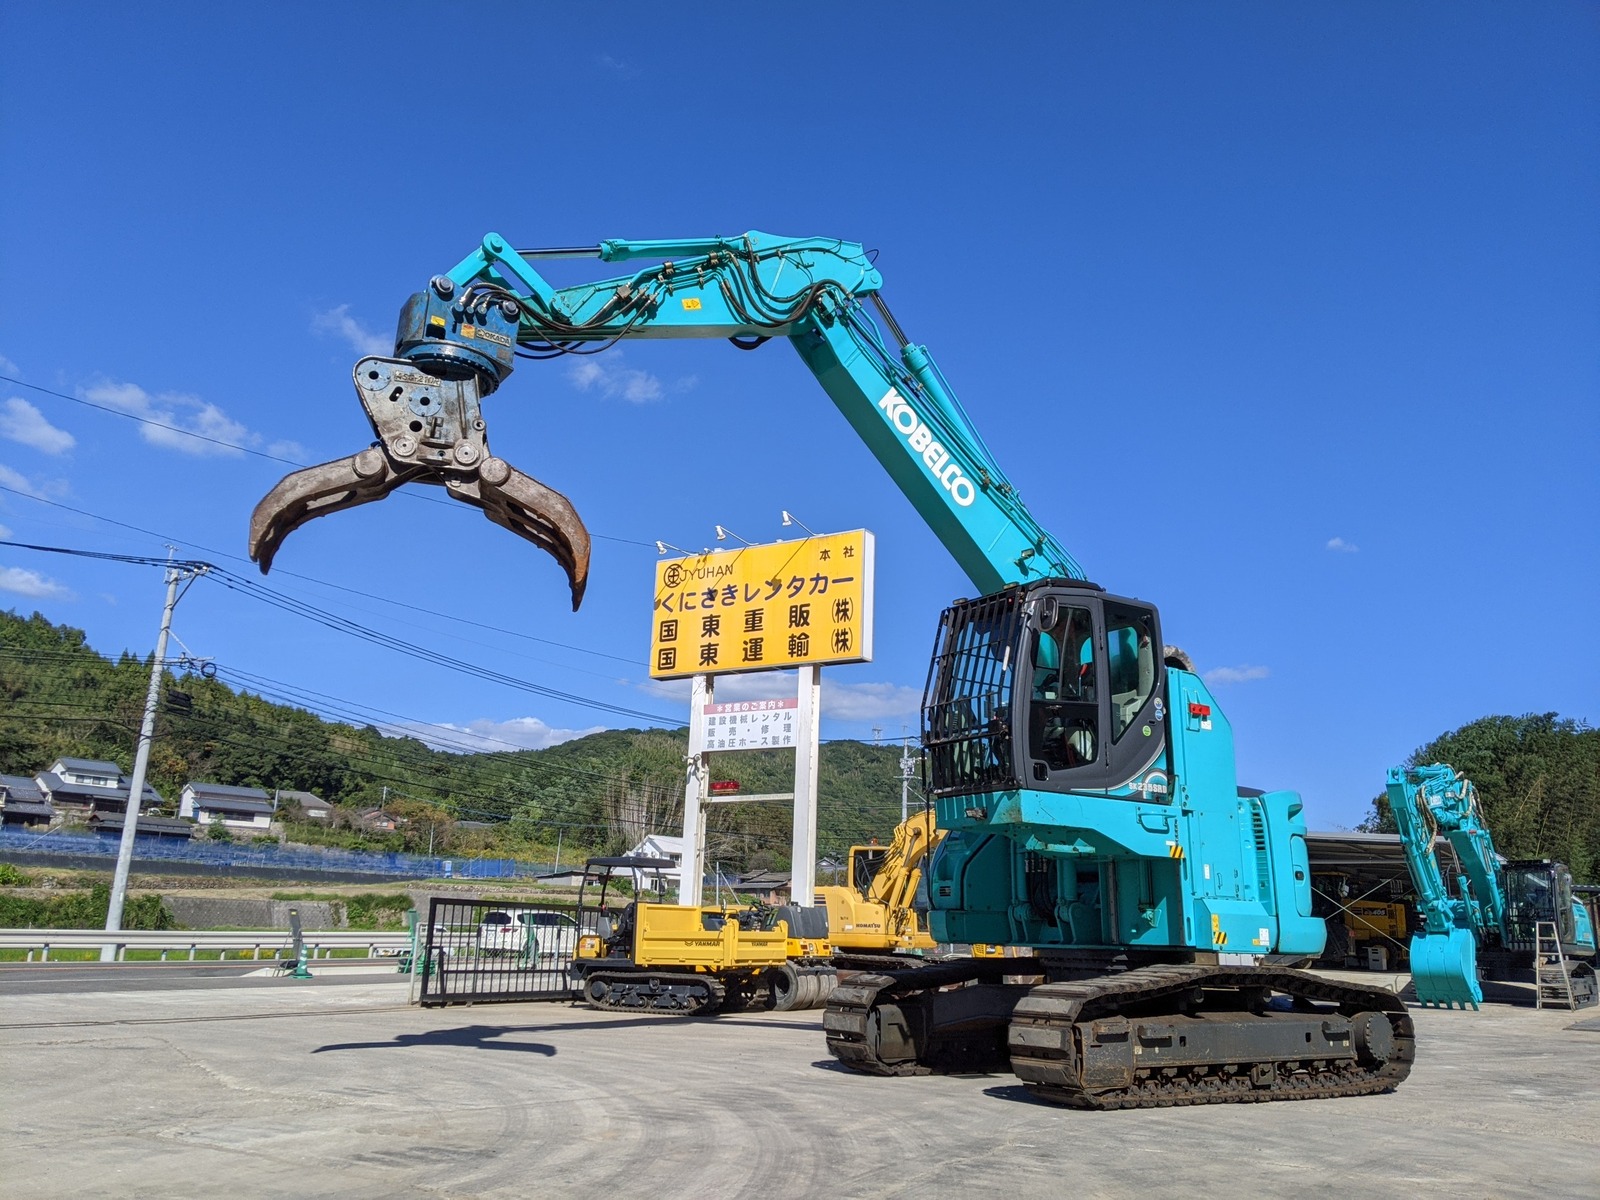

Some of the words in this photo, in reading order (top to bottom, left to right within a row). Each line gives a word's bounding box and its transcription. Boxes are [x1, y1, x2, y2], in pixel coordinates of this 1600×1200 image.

[484, 332, 511, 345] OKADA
[878, 386, 975, 507] KOBELCO
[819, 545, 855, 561] 本社
[680, 564, 734, 582] JYUHAN
[662, 572, 854, 613] くにさきレンタカー
